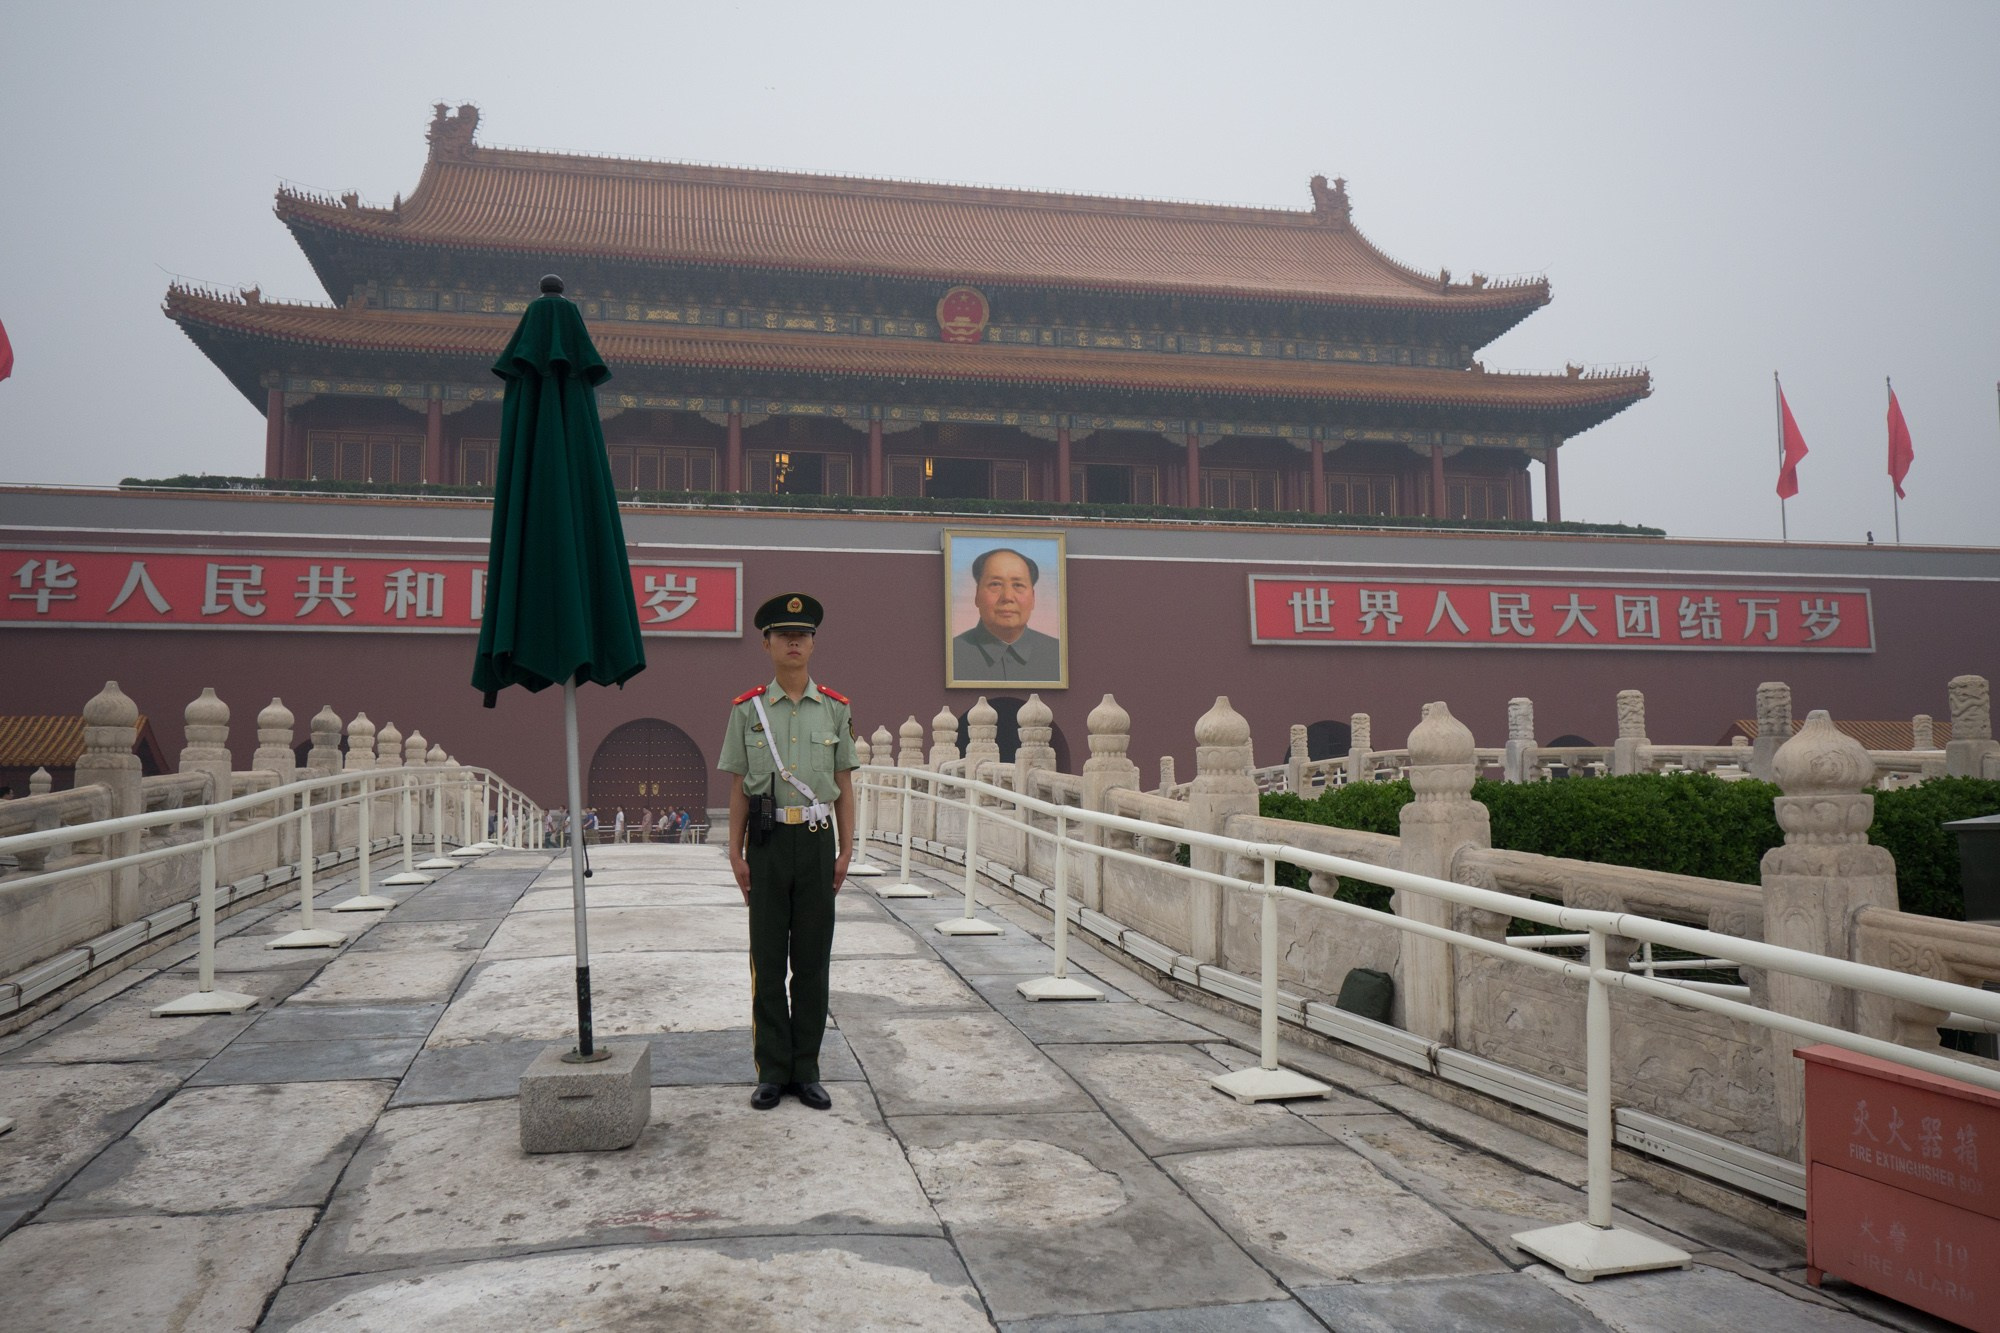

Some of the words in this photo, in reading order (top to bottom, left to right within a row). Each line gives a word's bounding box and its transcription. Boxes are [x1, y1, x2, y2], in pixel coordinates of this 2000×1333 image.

[8, 559, 698, 623] 华人民共和岁
[1288, 588, 1841, 641] 世界人民大团结万岁
[1849, 1142, 1872, 1164] FIRE
[1876, 1150, 1955, 1188] EXTINGUISHER
[1960, 1174, 1984, 1195] BOX
[1934, 1236, 1969, 1273] 119
[1905, 1267, 1975, 1304] ALARM
